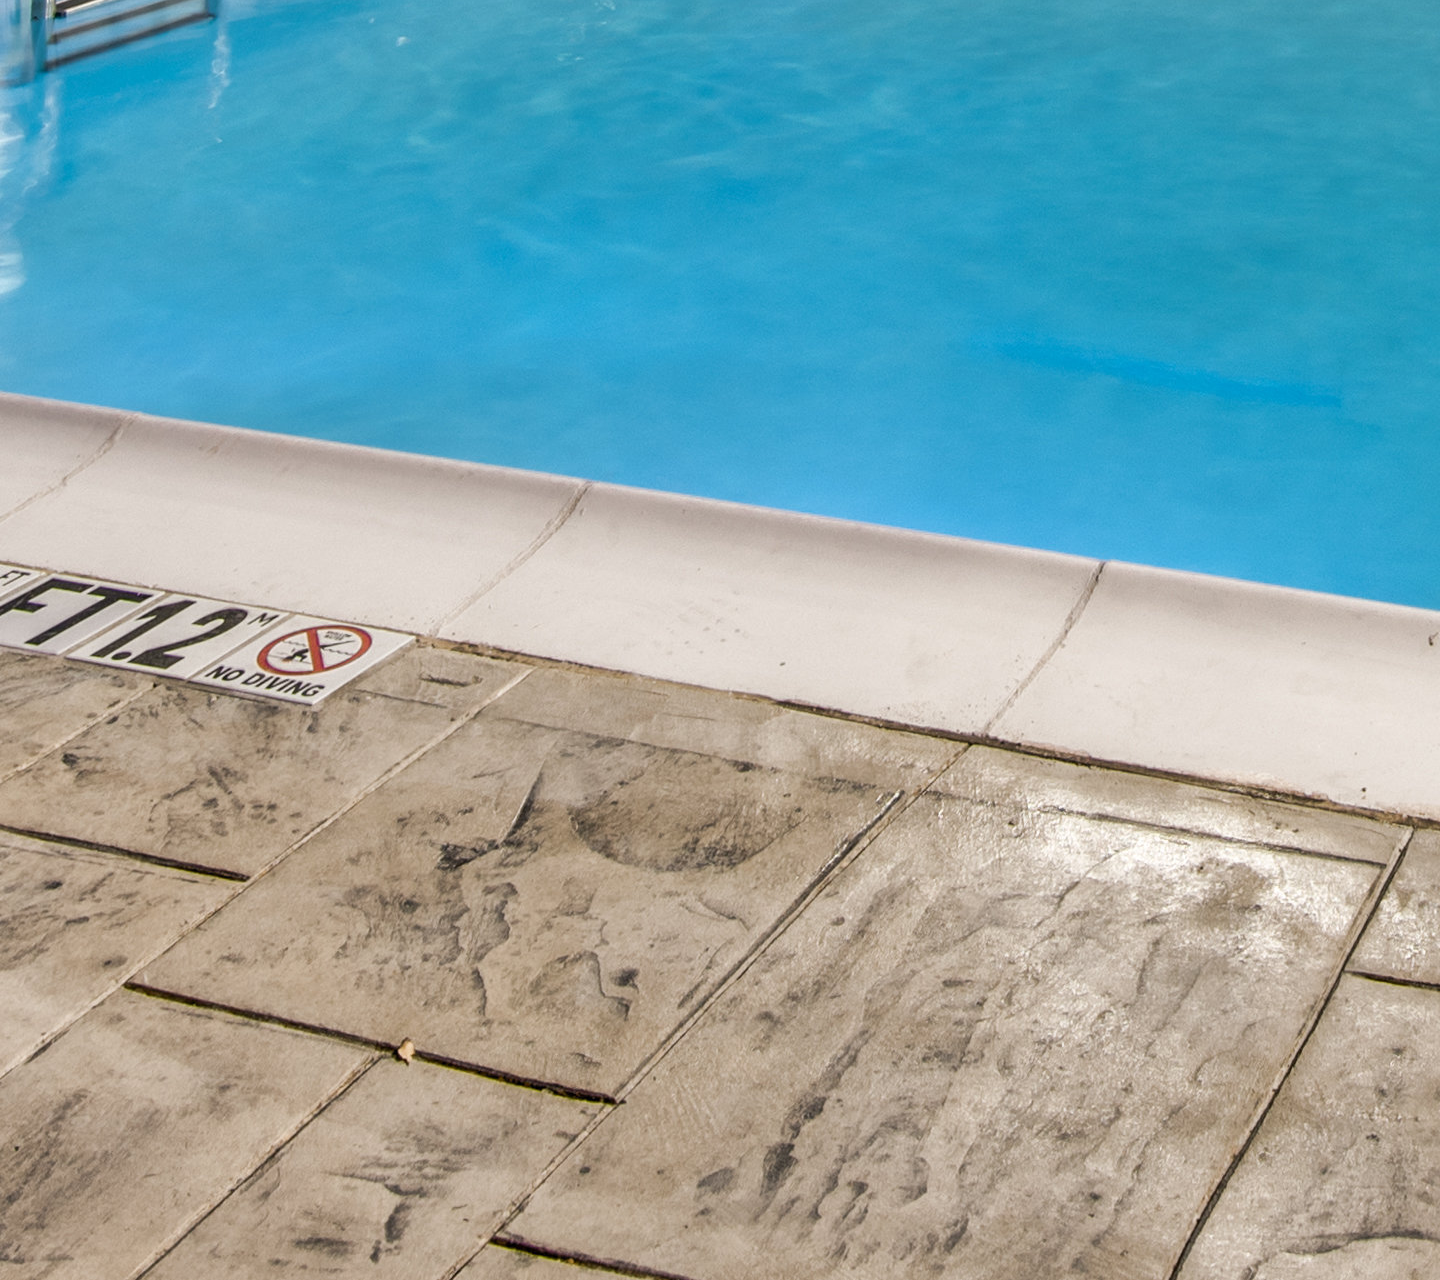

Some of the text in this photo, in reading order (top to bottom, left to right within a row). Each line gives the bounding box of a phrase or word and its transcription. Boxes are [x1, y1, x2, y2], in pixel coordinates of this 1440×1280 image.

[90, 600, 248, 668] 1.2
[248, 611, 278, 627] M
[205, 665, 325, 697] NO DIVING
